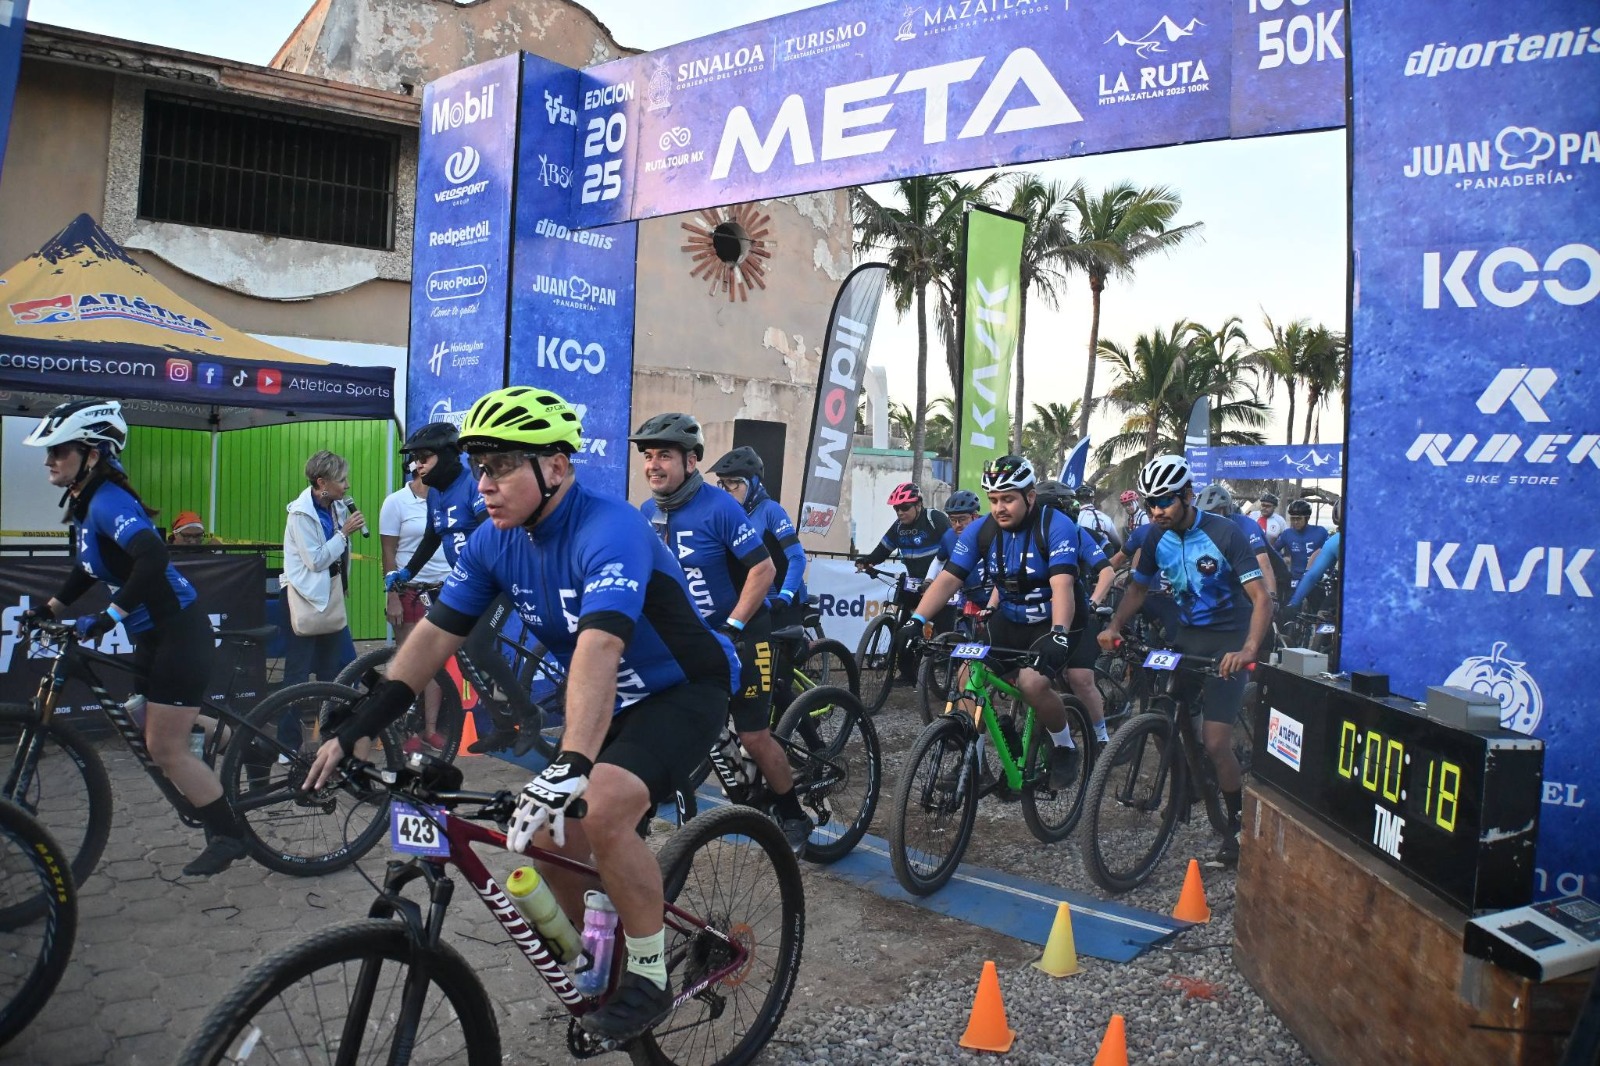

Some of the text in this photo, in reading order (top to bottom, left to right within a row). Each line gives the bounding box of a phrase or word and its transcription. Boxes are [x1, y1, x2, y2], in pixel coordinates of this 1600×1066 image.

[924, 5, 1049, 36] BIENESTAR PARA TODOS
[784, 21, 866, 54] TURISMO
[1258, 9, 1345, 70] 50K
[676, 64, 764, 91] GOBIERNO DEL ESTADO
[677, 44, 765, 82] SINALOA
[1099, 59, 1209, 96] LA RUTA
[432, 84, 495, 135] Mobil
[584, 81, 634, 110] EDICION
[1098, 82, 1209, 106] MTB MAZATLAN 2025 100K
[710, 47, 1084, 181] META
[584, 112, 627, 158] 20
[644, 150, 704, 173] RUTA TOUR MX
[1403, 140, 1490, 178] JUAN
[434, 180, 489, 203] VELOSPORT
[581, 159, 622, 204] 25
[456, 275, 485, 289] POLLO
[532, 275, 616, 306] JUAN PAN
[452, 355, 480, 368] Express
[970, 277, 1009, 450] KASK
[288, 377, 342, 394] Atletica
[346, 382, 390, 399] Sports
[1465, 474, 1560, 486] BIKE STORE
[676, 530, 695, 559] LA
[1415, 541, 1596, 598] KASK
[684, 566, 716, 619] RUTA
[958, 646, 981, 656] 353
[1153, 654, 1169, 665] 62
[400, 816, 435, 844] 423
[1373, 803, 1406, 861] TIME
[35, 843, 68, 903] MAXXIS
[471, 877, 584, 1006] SPECIALIZED
